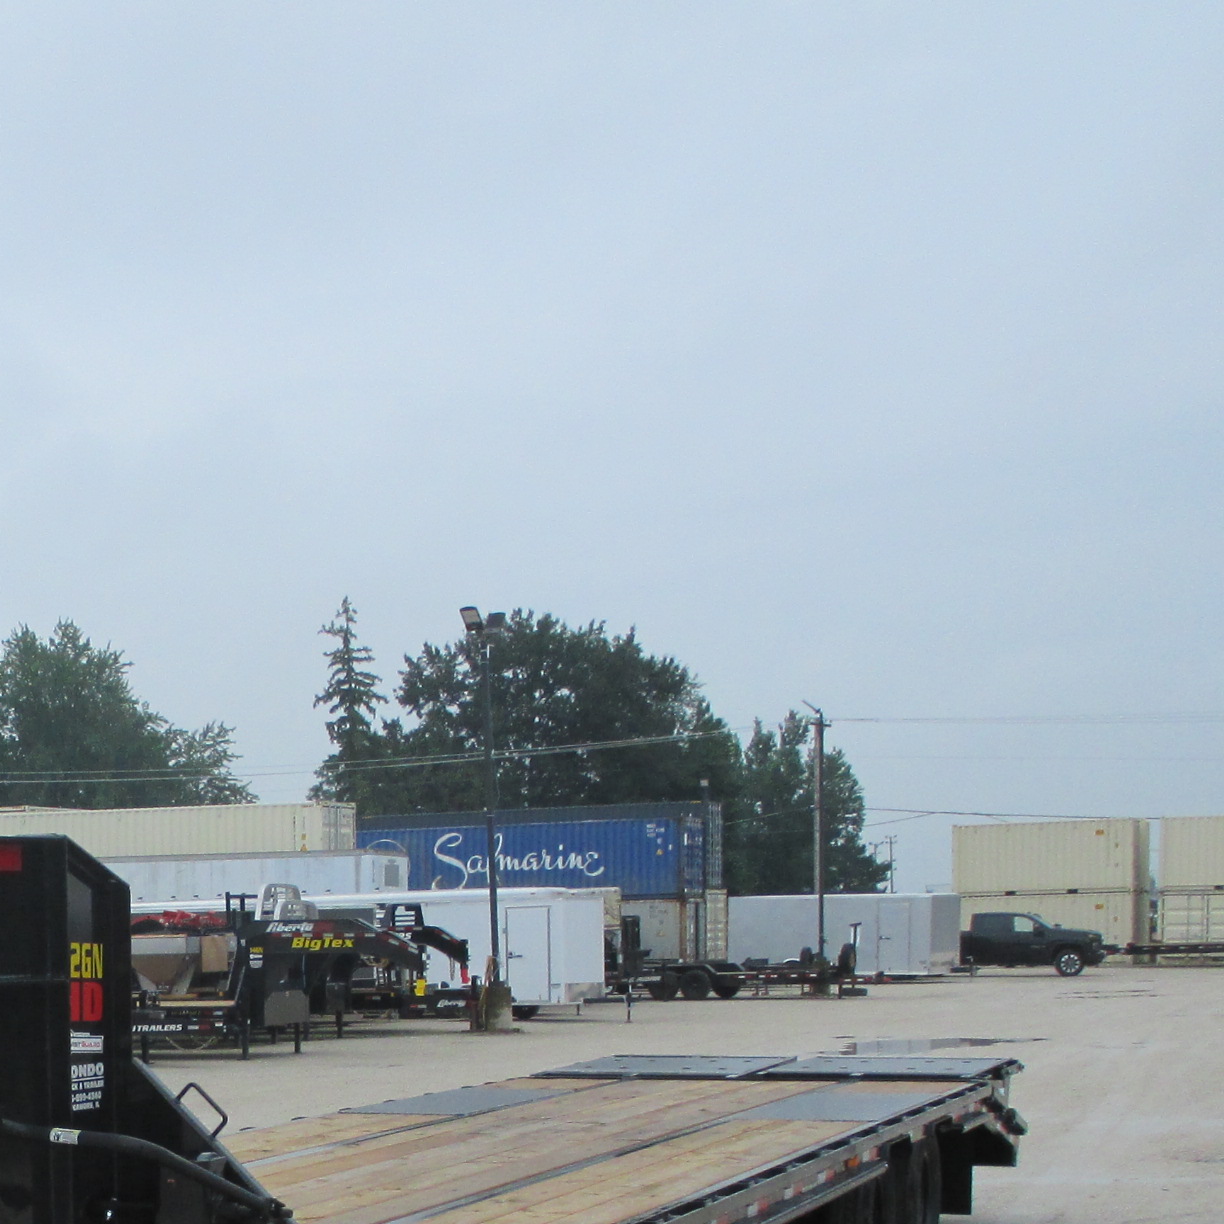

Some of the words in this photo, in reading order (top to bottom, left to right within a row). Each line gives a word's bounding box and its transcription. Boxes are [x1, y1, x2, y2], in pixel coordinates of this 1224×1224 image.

[291, 937, 355, 951] BigTex
[70, 942, 103, 979] 2GN
[137, 1024, 183, 1032] TRAILERS
[70, 1062, 105, 1079] ONDO
